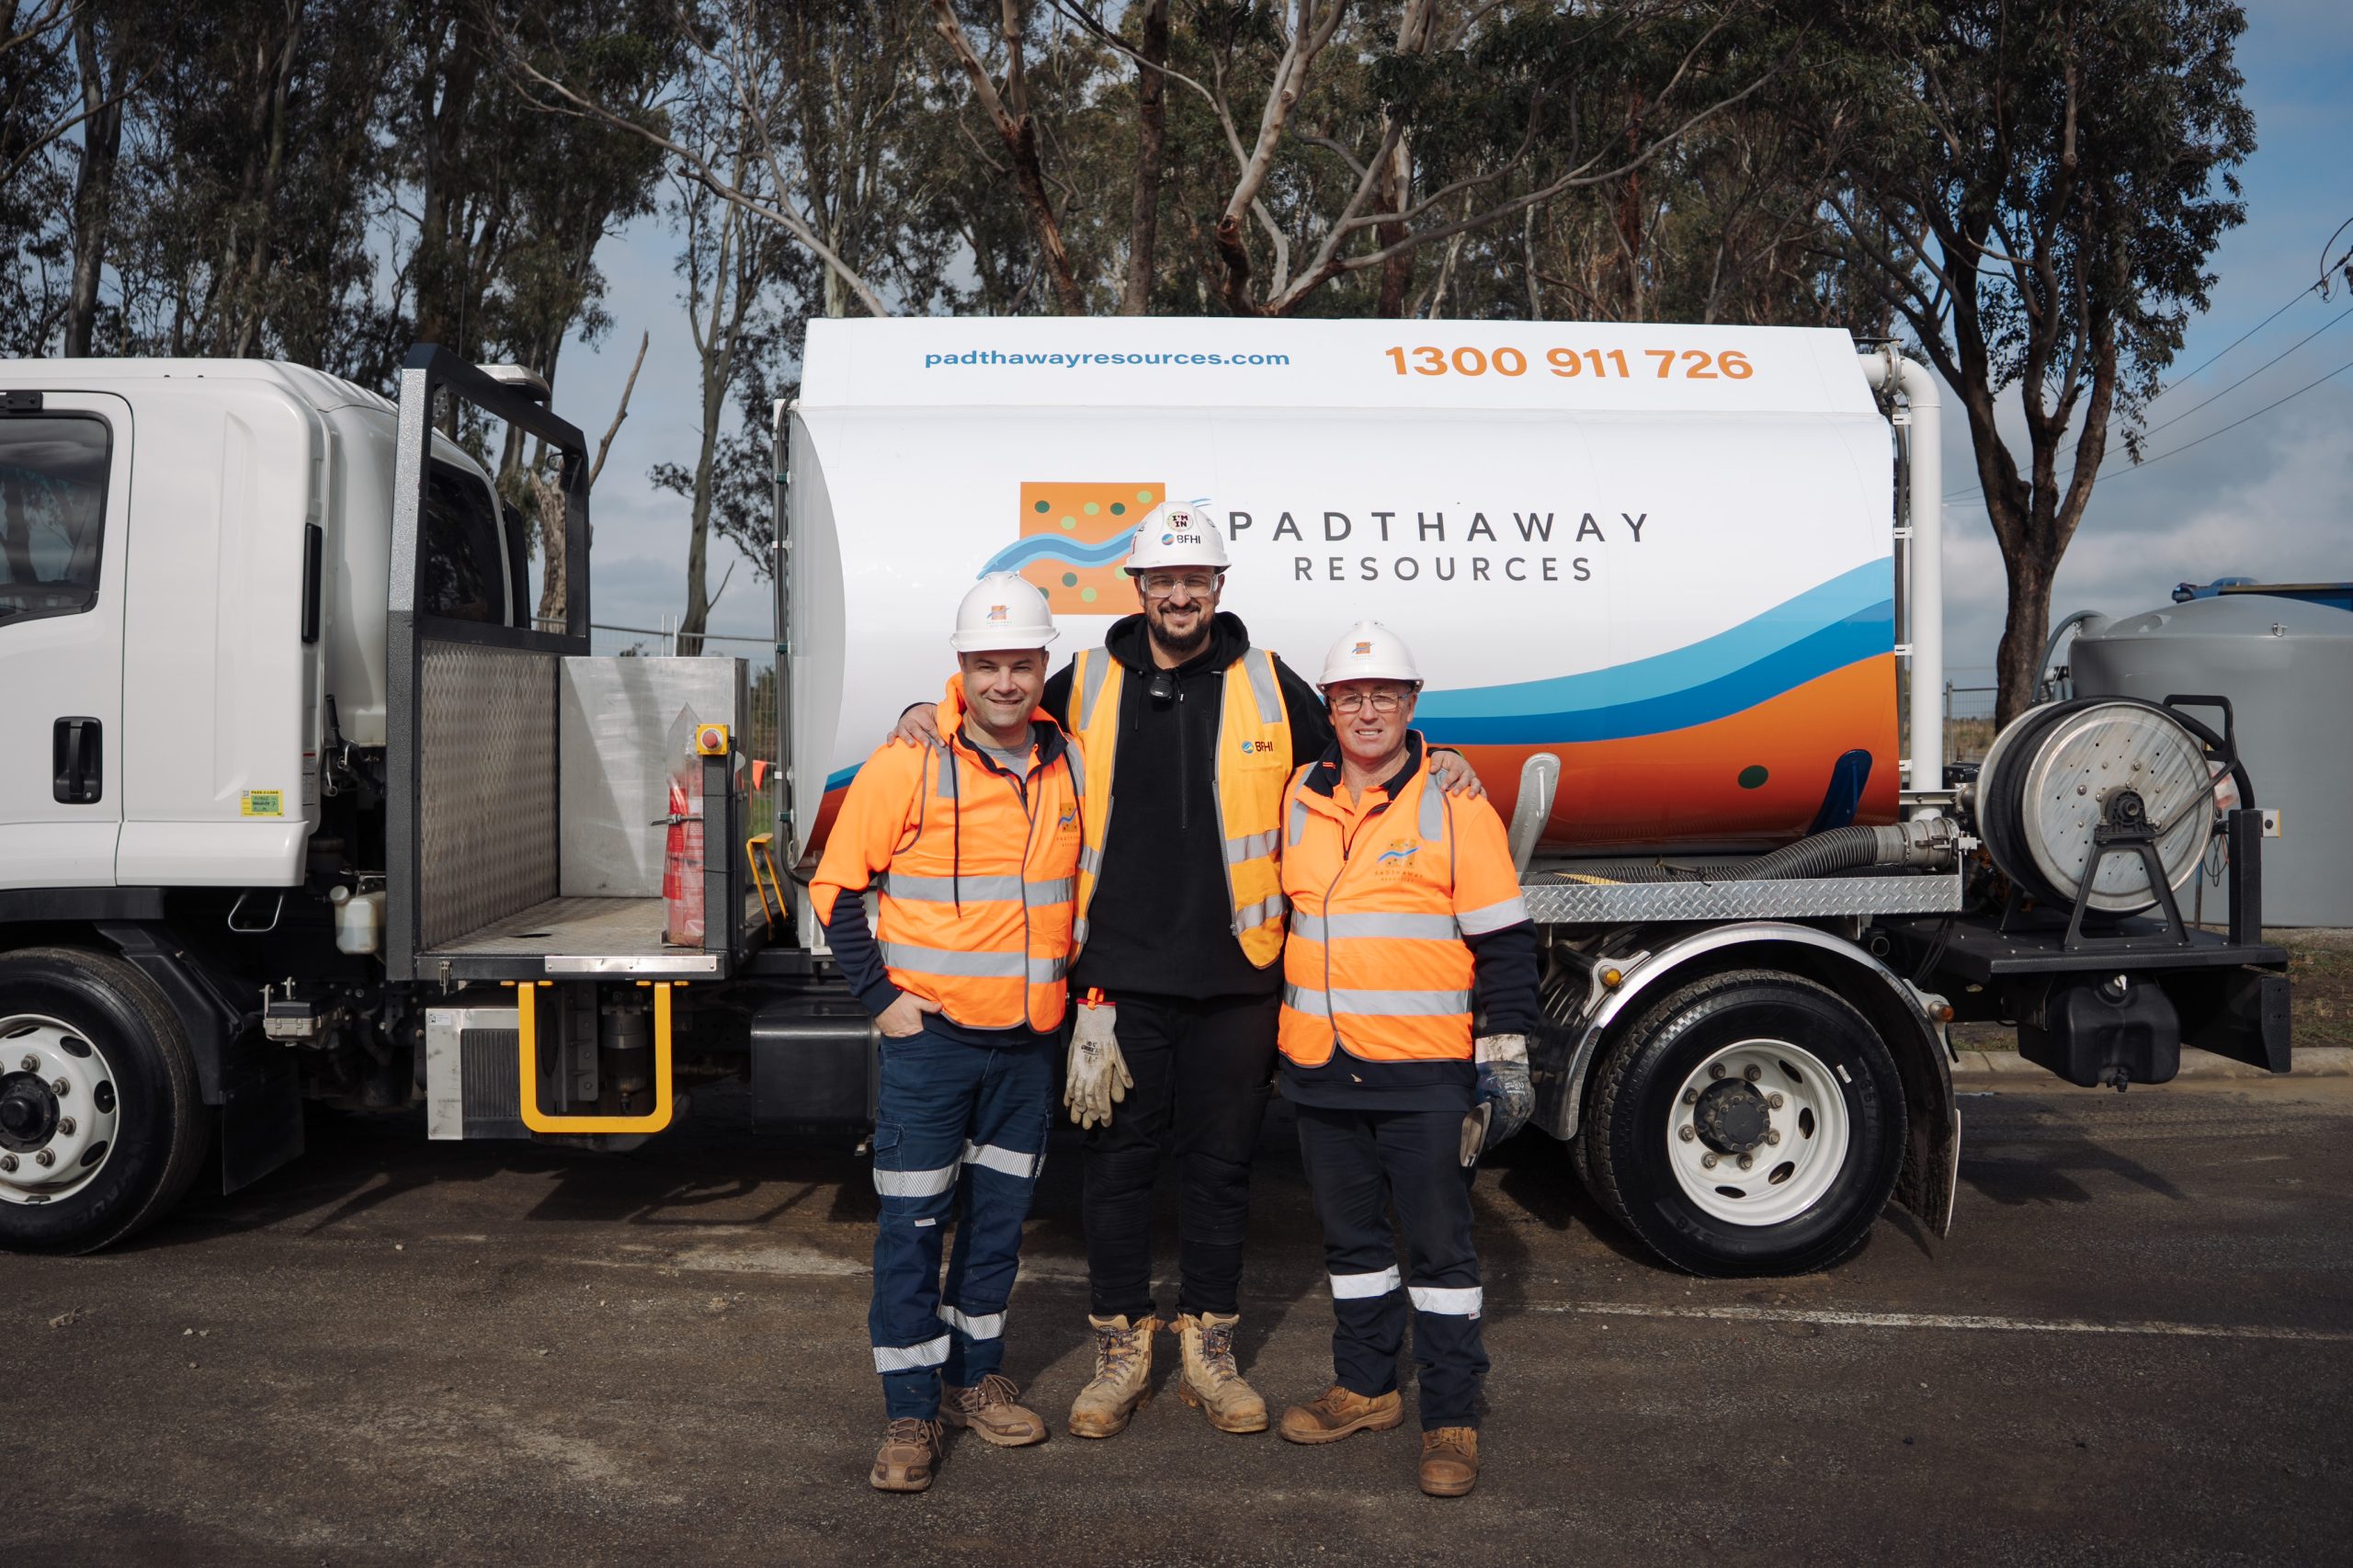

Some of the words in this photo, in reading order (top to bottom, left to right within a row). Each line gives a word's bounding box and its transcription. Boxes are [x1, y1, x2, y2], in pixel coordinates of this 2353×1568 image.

[925, 349, 1290, 369] padthawayresources.com
[1385, 347, 1528, 377] 1300
[1546, 347, 1630, 378] 911
[1644, 349, 1754, 380] 726
[1229, 511, 1648, 543] PADTHAWAY
[1176, 535, 1201, 544] BFHI
[1294, 556, 1591, 582] RESOURCES
[1255, 741, 1274, 752] BFHI
